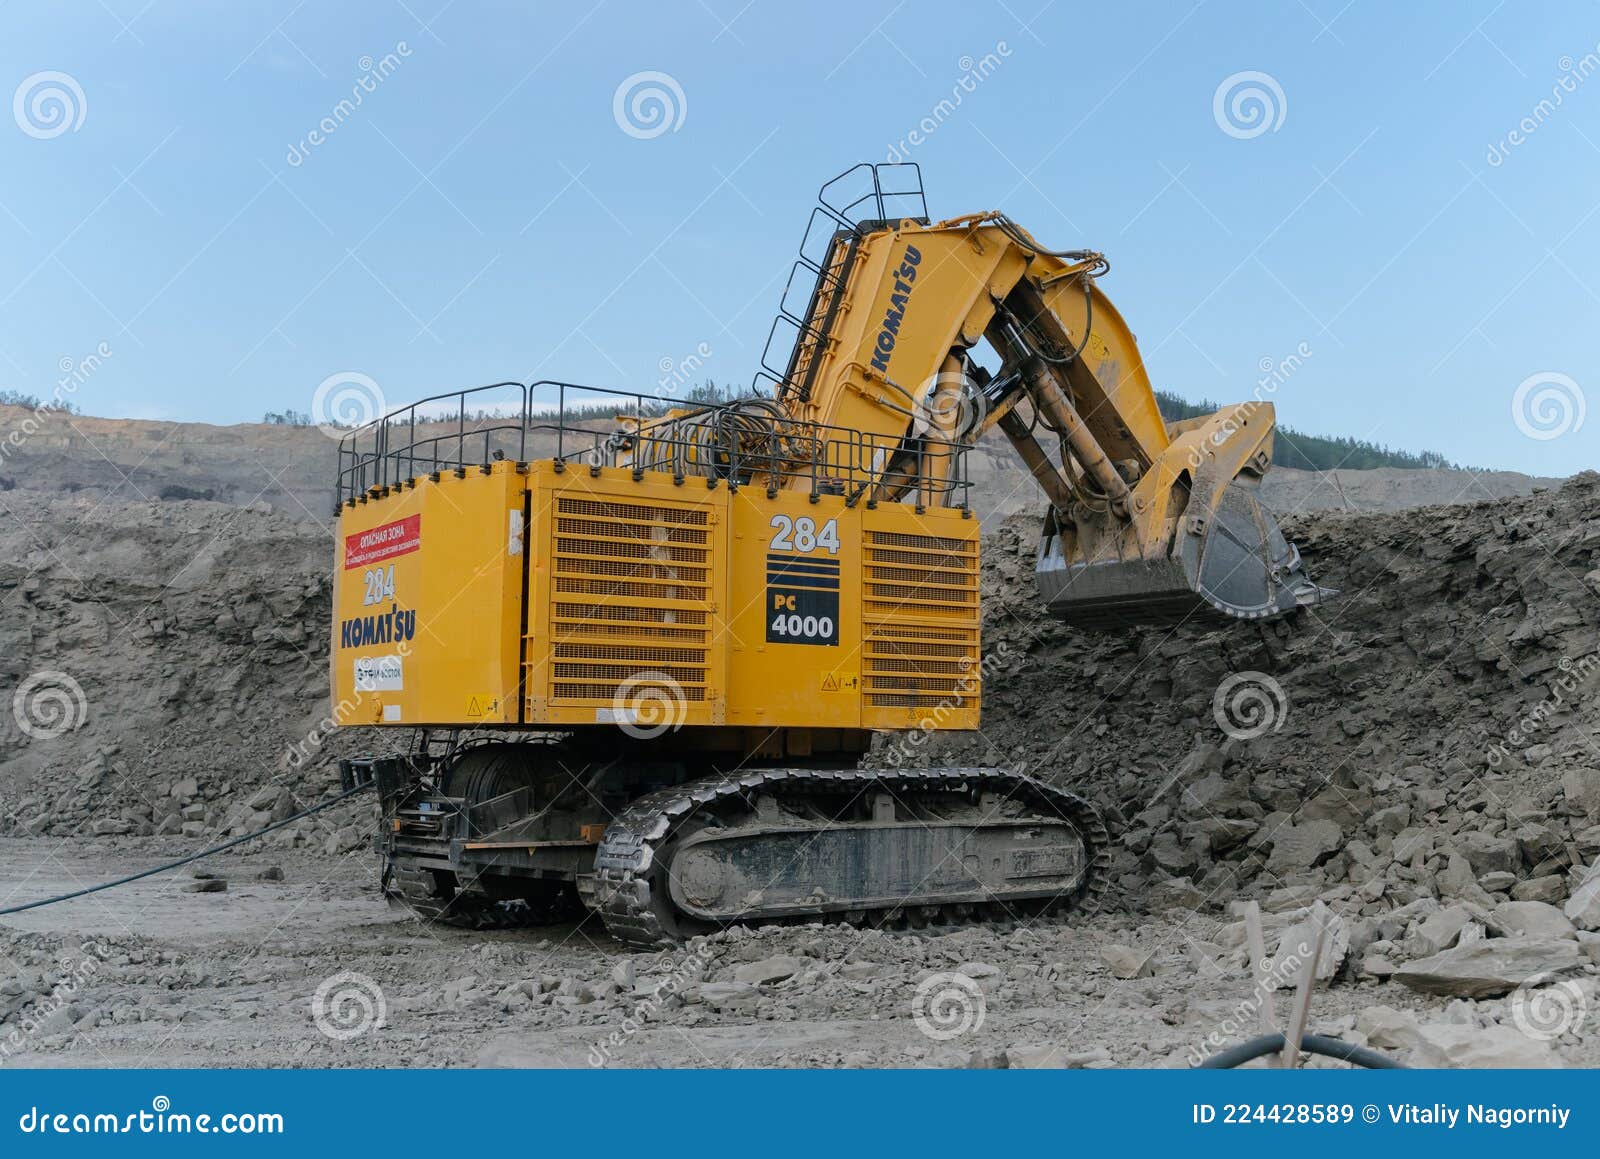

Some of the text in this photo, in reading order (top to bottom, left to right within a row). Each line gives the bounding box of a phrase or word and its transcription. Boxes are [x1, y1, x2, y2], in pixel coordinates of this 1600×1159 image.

[870, 244, 922, 373] KOMATSU
[388, 524, 405, 540] ЗОНА
[769, 514, 840, 554] 284
[363, 564, 395, 606] 284
[774, 594, 796, 611] PC
[341, 603, 416, 649] KOMATSU
[771, 614, 834, 638] 4000
